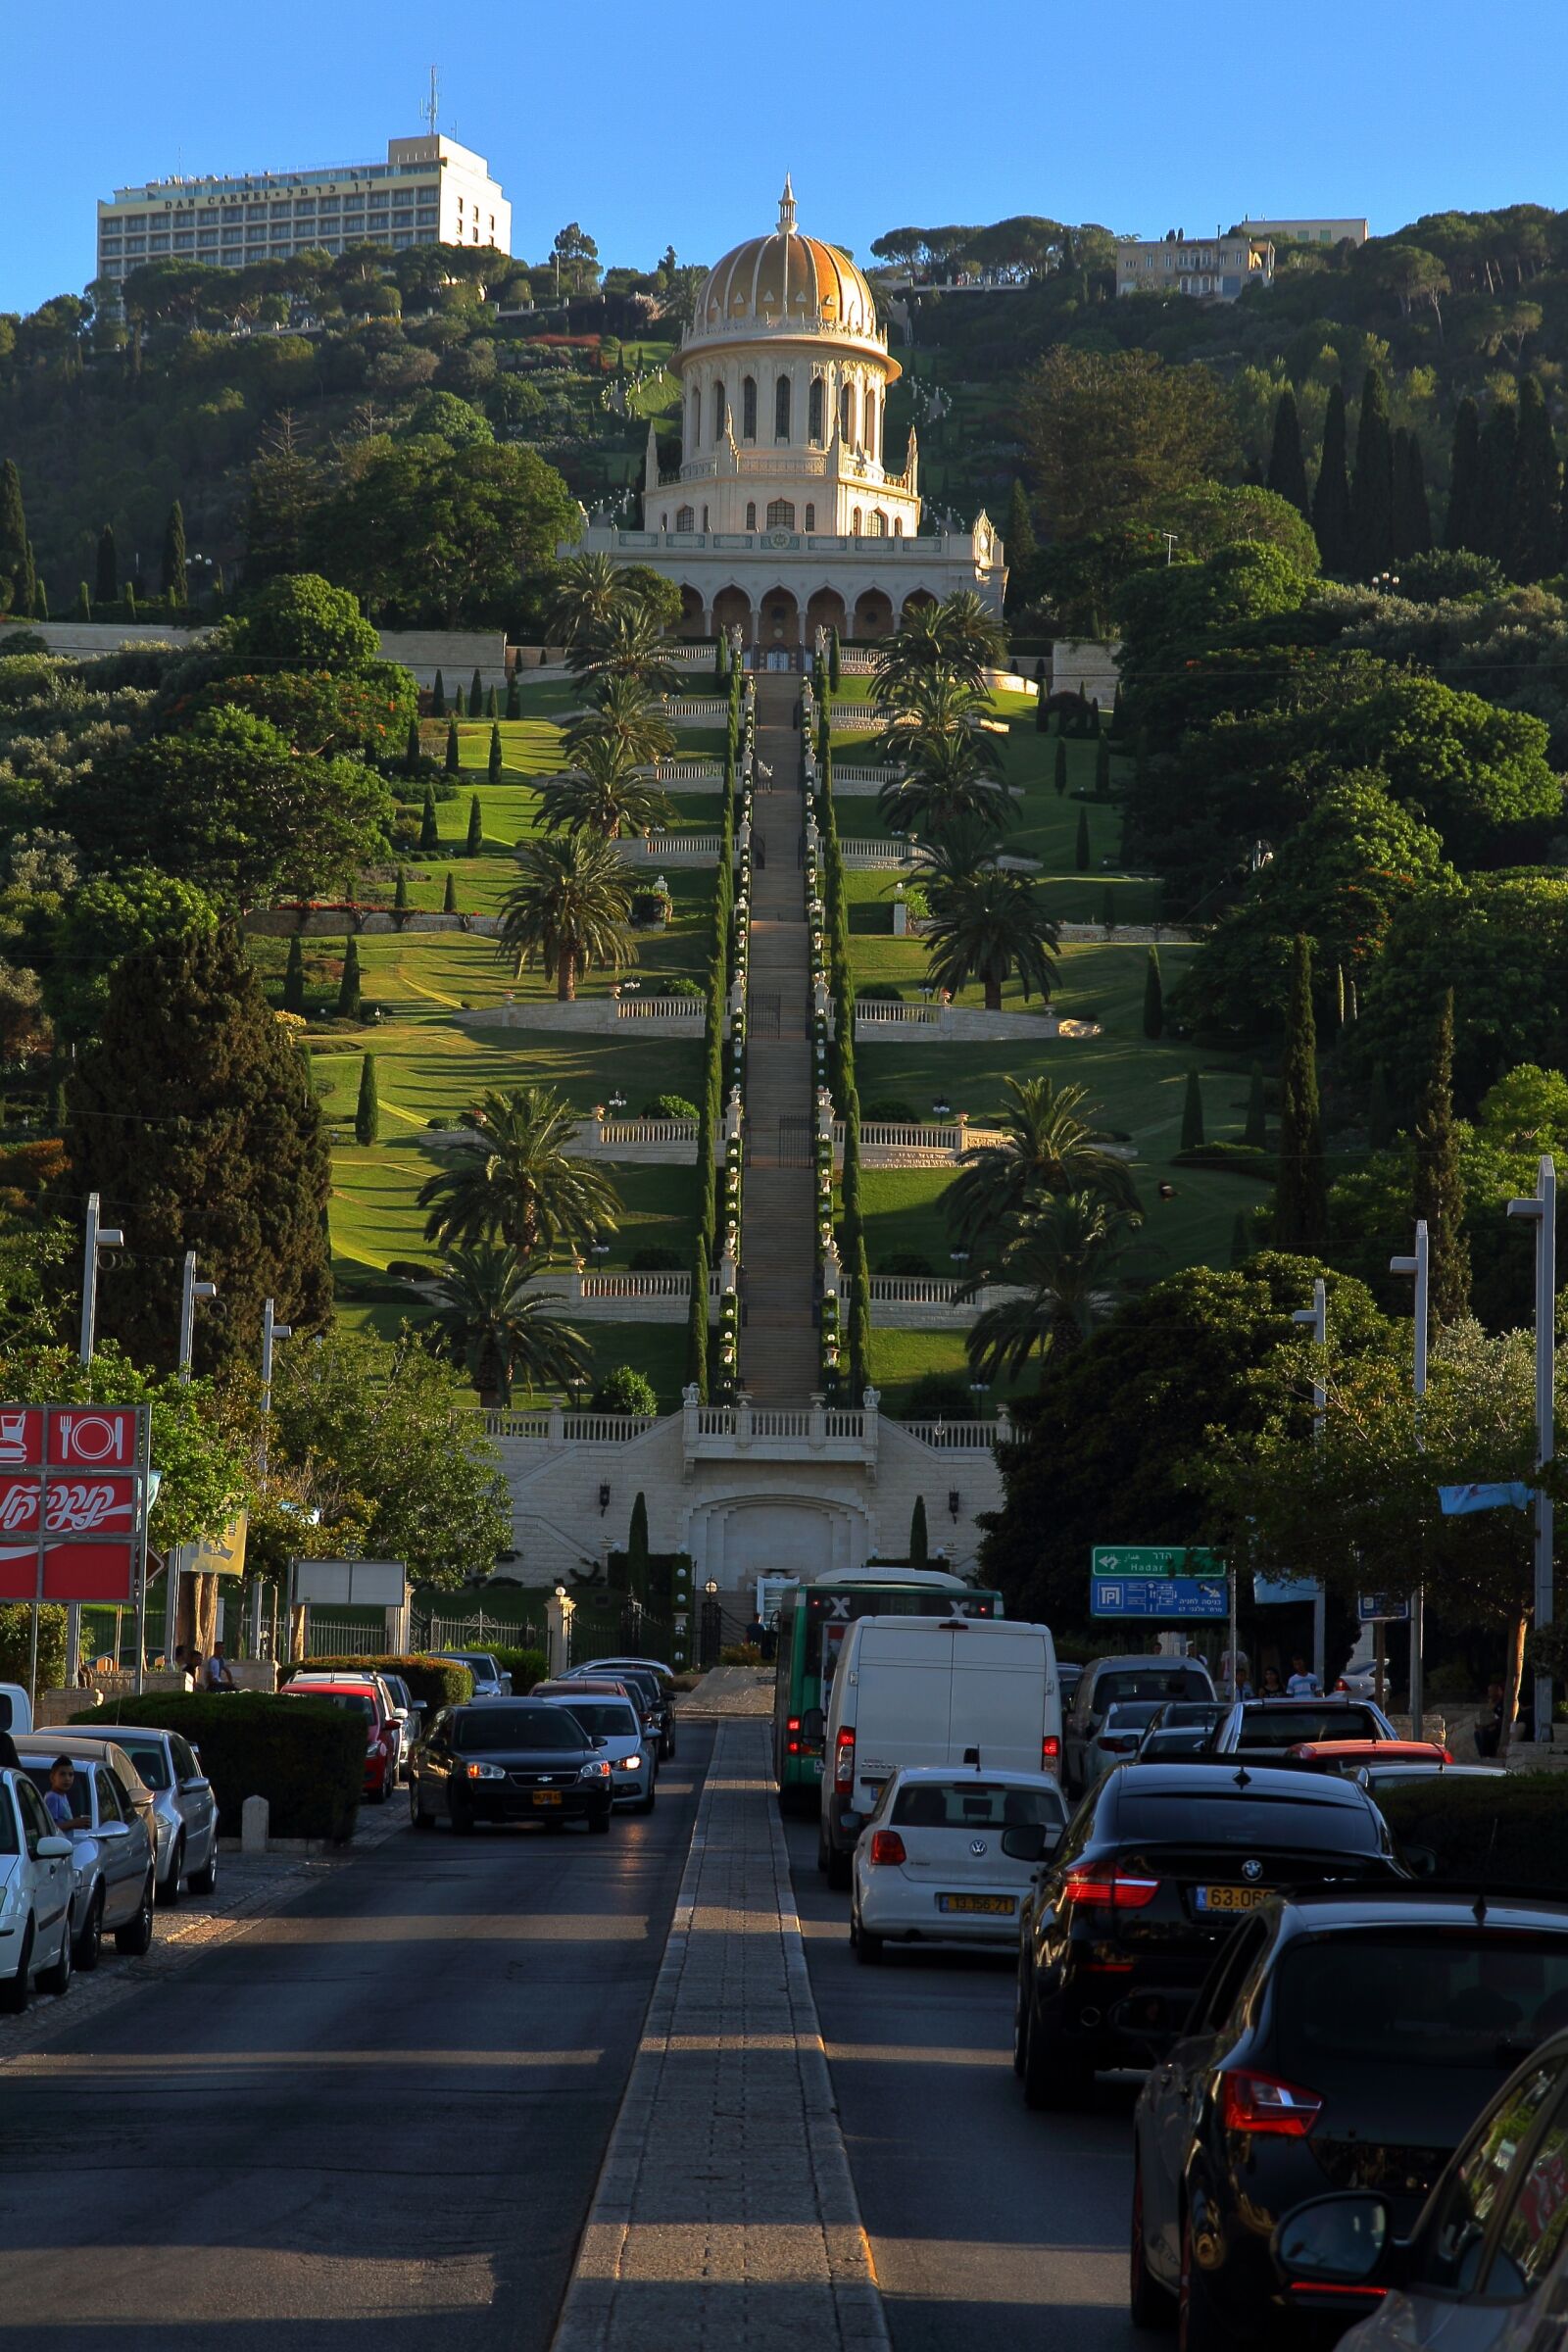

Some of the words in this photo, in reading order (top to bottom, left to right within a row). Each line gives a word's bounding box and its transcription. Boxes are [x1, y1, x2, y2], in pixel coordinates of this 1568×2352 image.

[286, 184, 336, 198] כרמל
[354, 179, 372, 193] דן
[165, 198, 195, 210] DAN
[207, 190, 271, 206] CARMEL
[1152, 1551, 1172, 1560] הדר
[1130, 1562, 1164, 1572] Hadar
